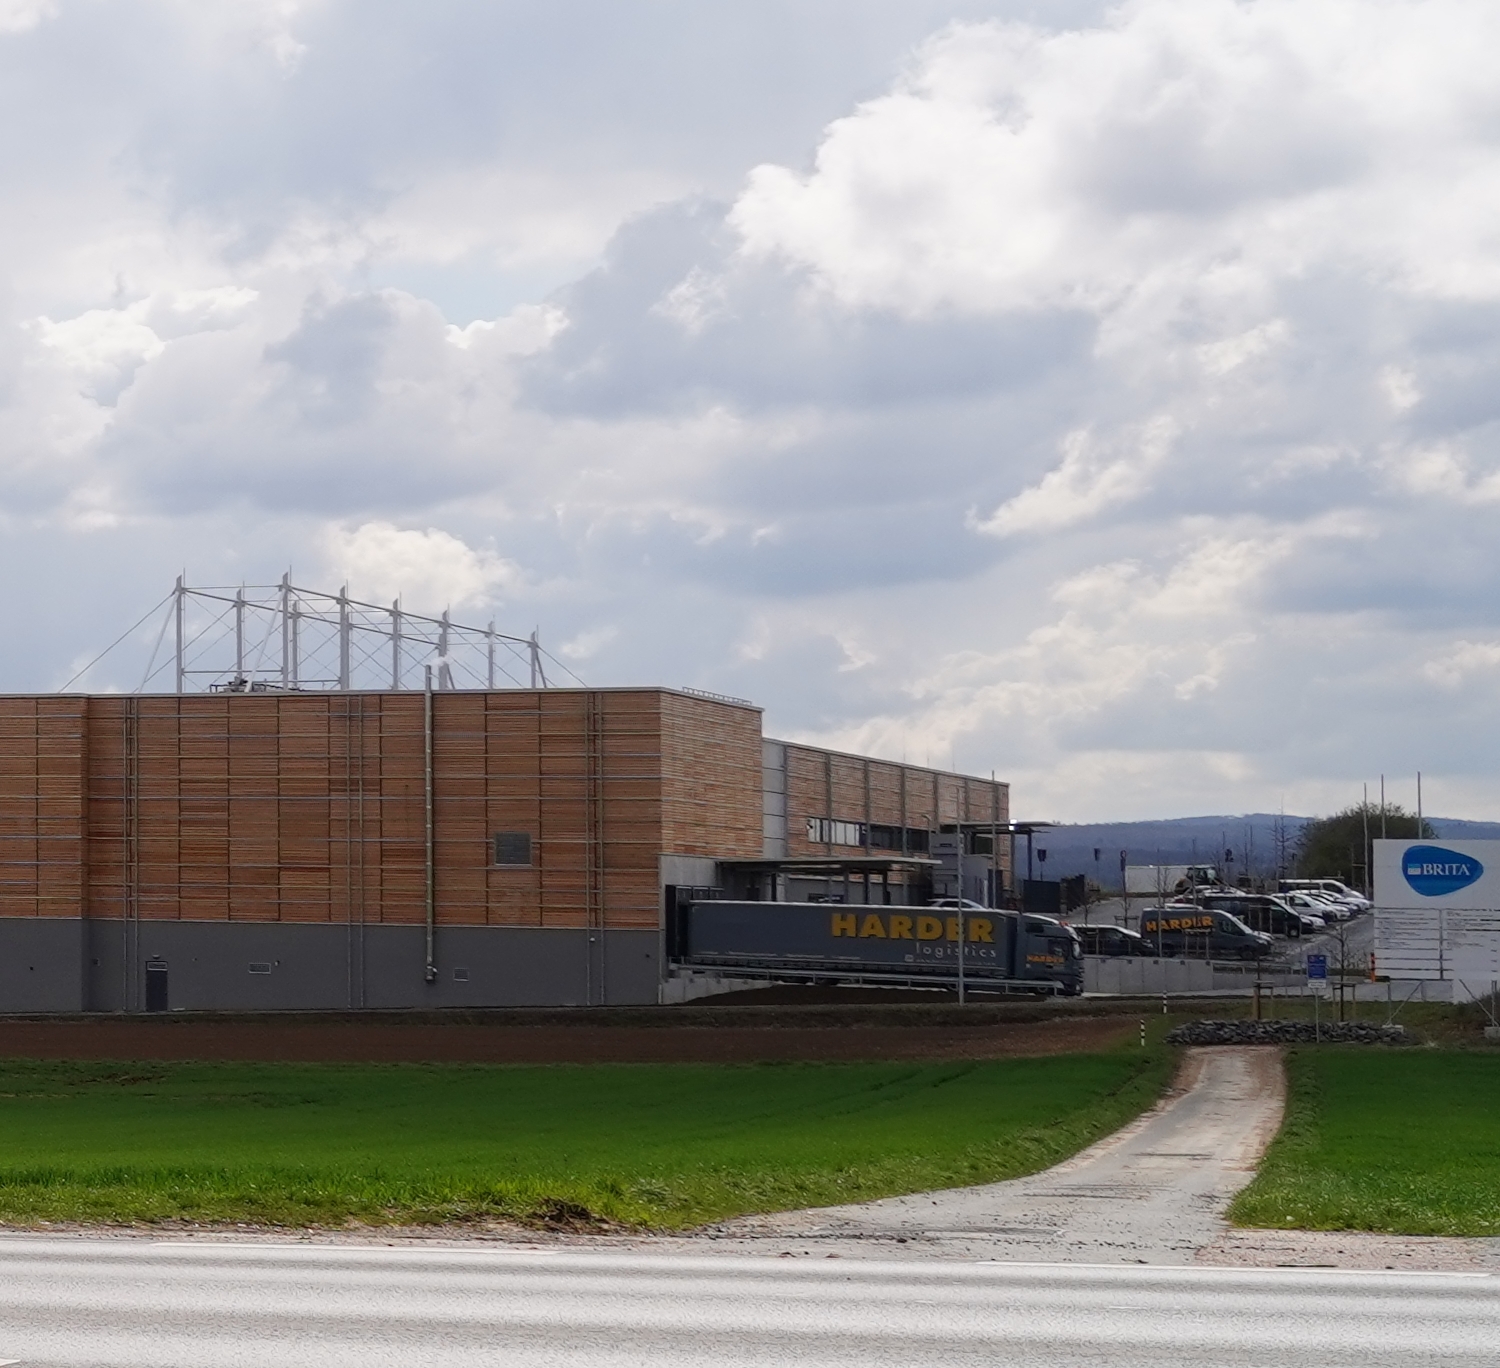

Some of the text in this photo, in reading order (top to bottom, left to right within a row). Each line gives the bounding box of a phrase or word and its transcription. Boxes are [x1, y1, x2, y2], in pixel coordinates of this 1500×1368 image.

[1422, 863, 1470, 876] BRITA
[830, 913, 996, 944] HARDER
[1145, 915, 1214, 933] HARDER
[916, 941, 997, 959] logistics
